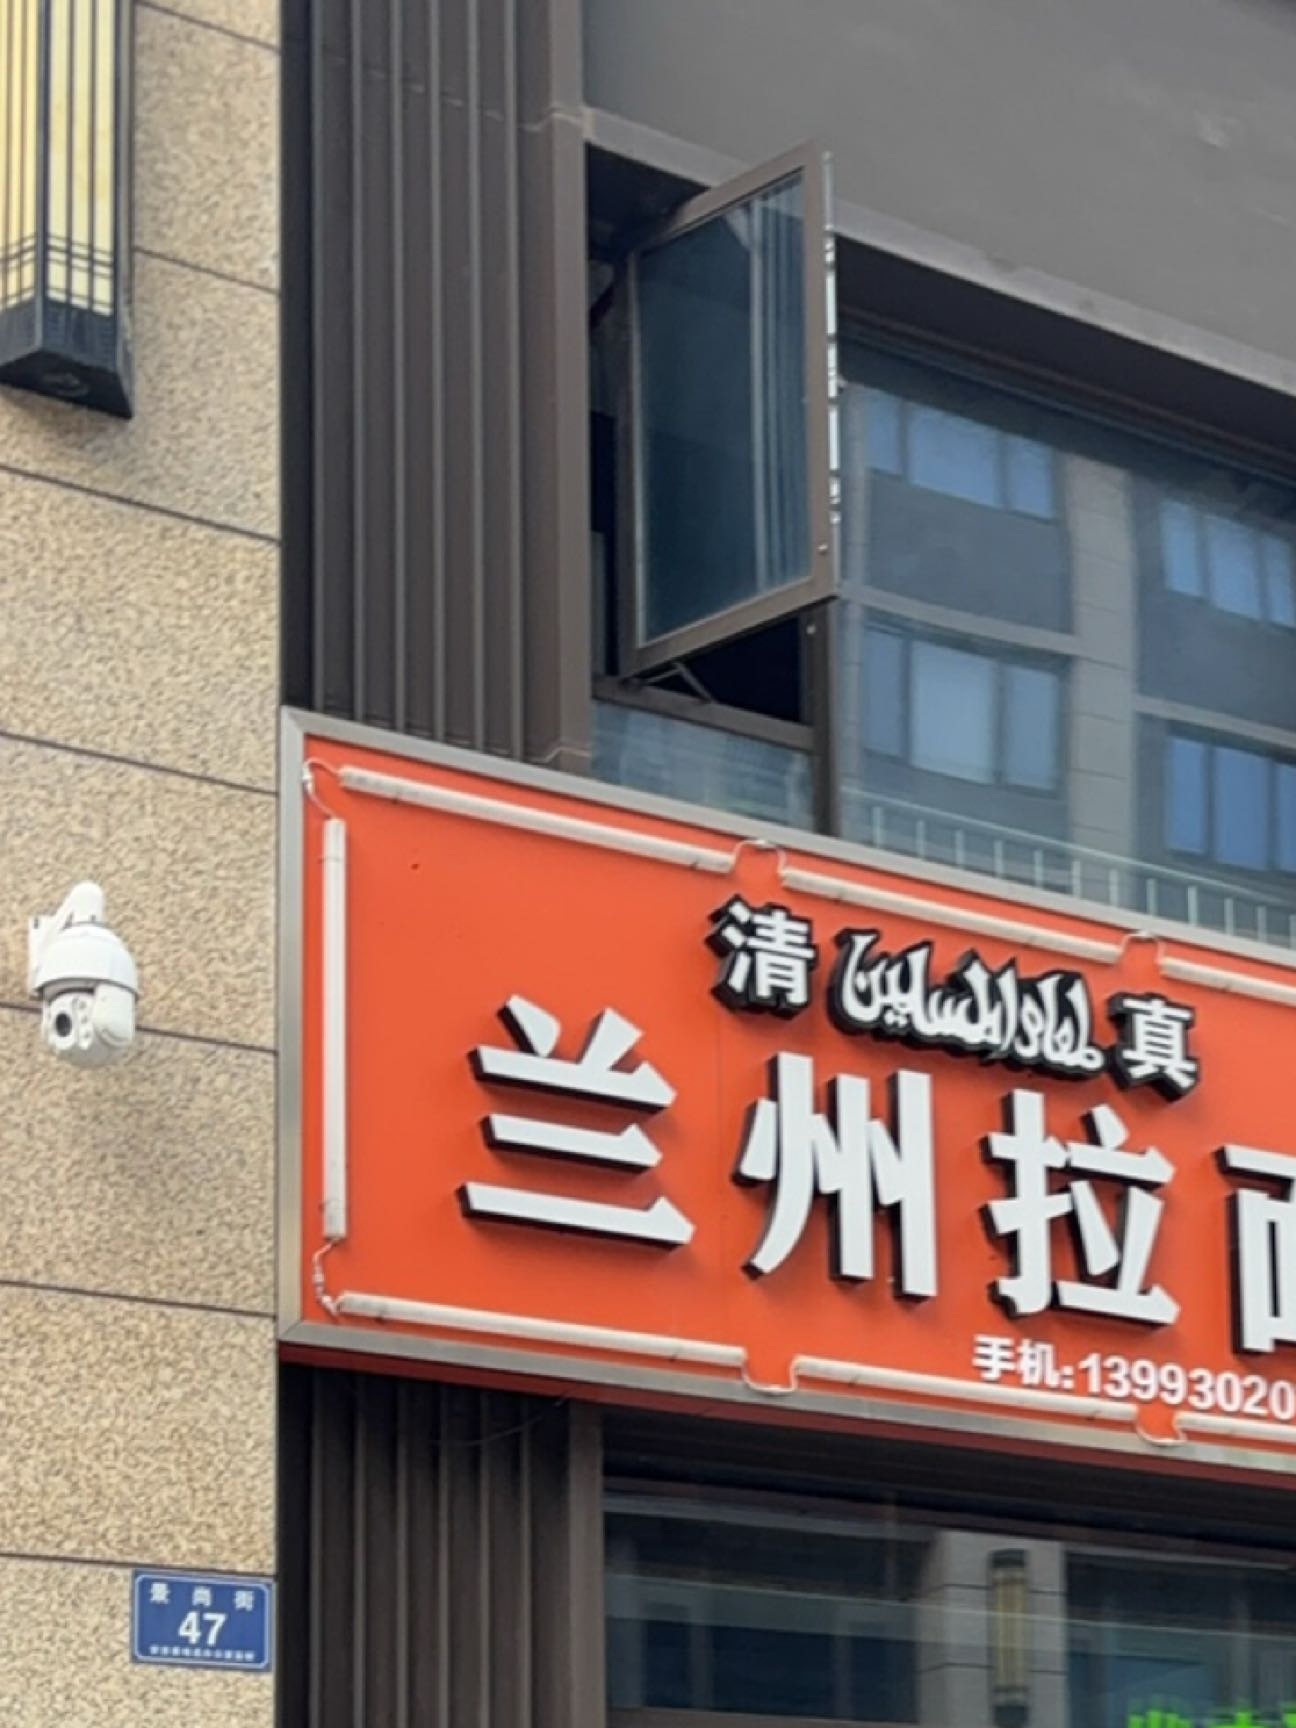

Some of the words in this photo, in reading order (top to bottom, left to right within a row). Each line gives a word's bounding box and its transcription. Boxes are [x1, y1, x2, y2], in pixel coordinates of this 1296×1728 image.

[715, 898, 814, 1008] 清
[1112, 994, 1200, 1092] 真
[178, 1611, 228, 1647] 47
